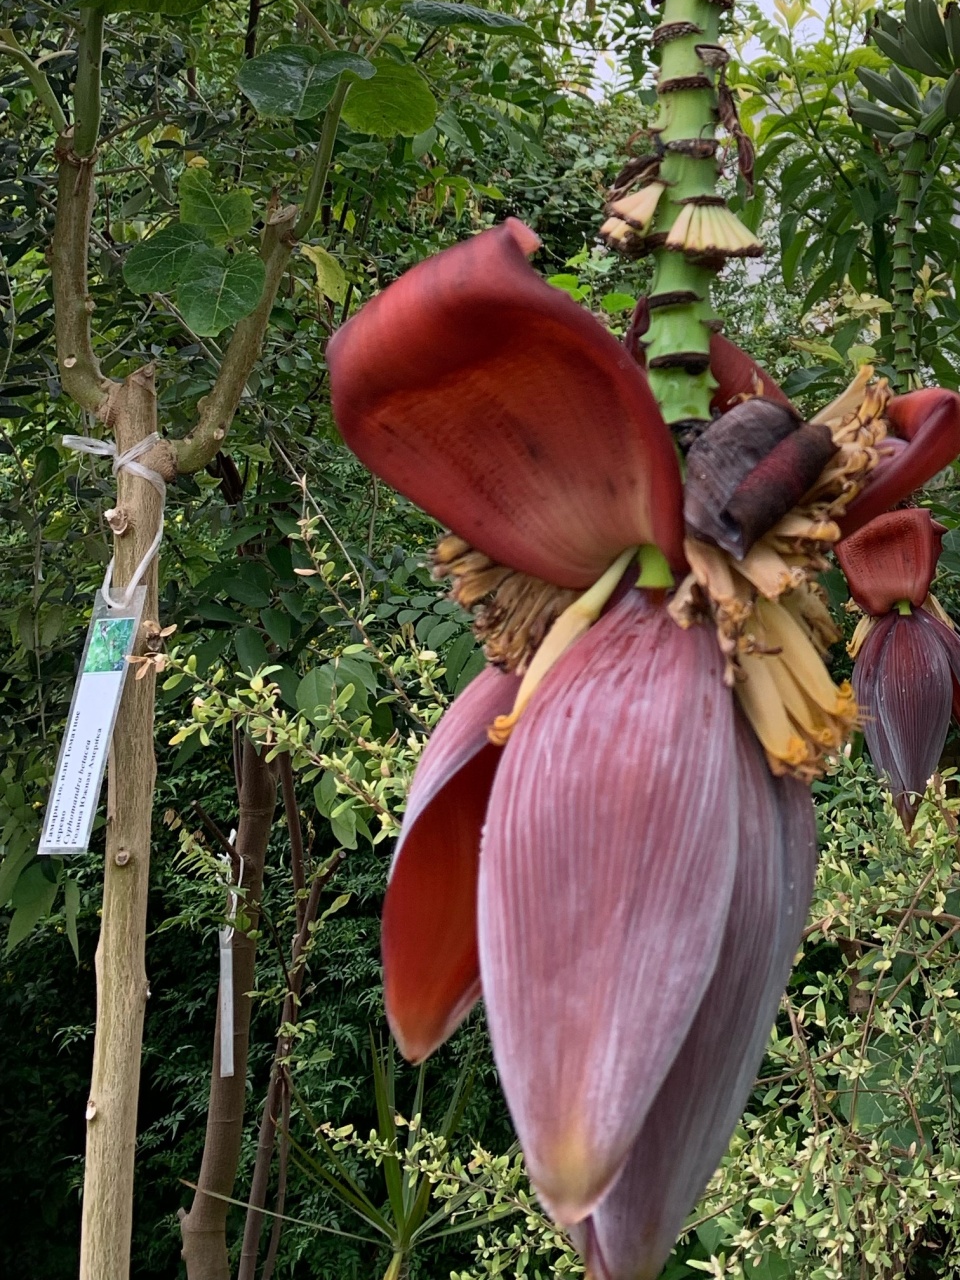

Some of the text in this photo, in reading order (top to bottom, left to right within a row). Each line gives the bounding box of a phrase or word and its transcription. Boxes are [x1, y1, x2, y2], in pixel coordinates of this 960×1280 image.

[64, 710, 81, 757] Томатное
[61, 762, 69, 781] или
[78, 740, 91, 775] betacea
[71, 810, 83, 845] Родина
[79, 772, 92, 807] Южная
